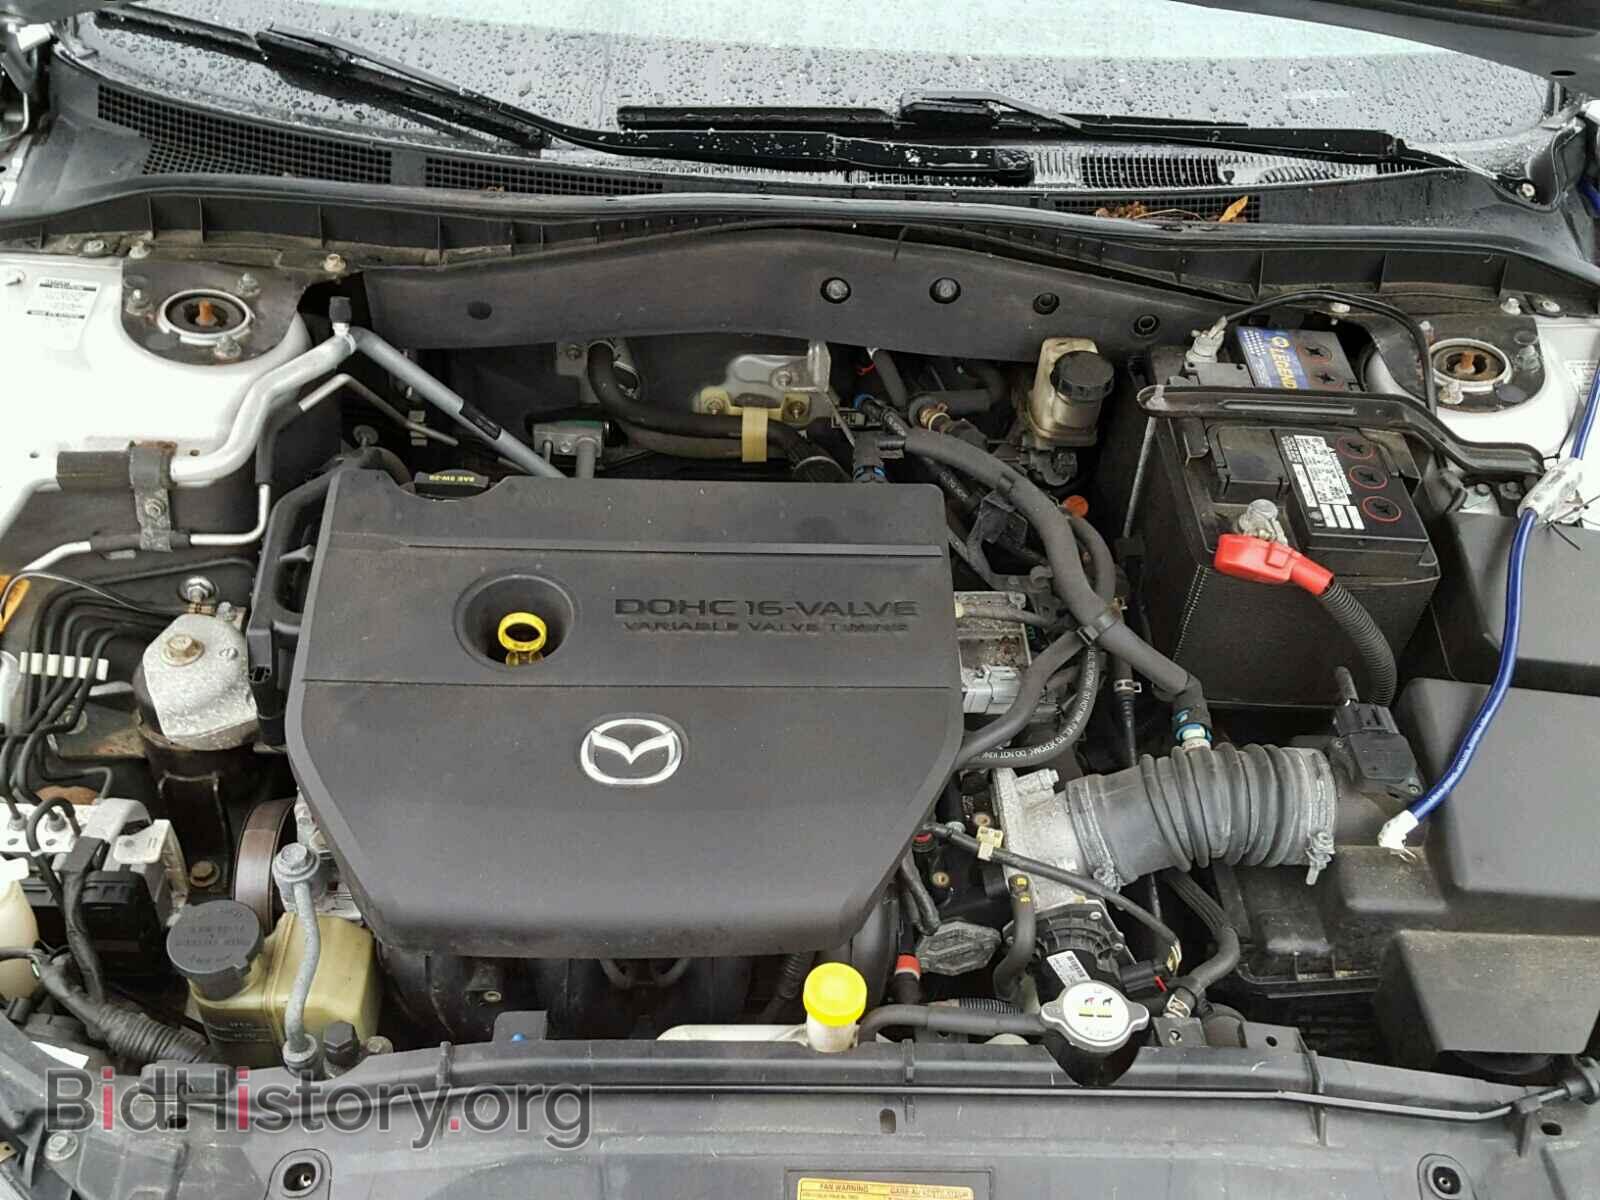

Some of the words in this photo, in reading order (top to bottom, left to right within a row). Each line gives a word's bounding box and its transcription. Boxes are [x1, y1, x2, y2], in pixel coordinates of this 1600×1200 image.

[1269, 348, 1297, 389] LEGEND
[615, 599, 737, 616] DOHC
[745, 600, 919, 617] 16-VALVE
[624, 621, 740, 632] VARIABLE
[749, 622, 819, 633] VALVE
[1000, 751, 1014, 759] NOT
[820, 1183, 833, 1192] FAN
[834, 1184, 869, 1194] WARNING
